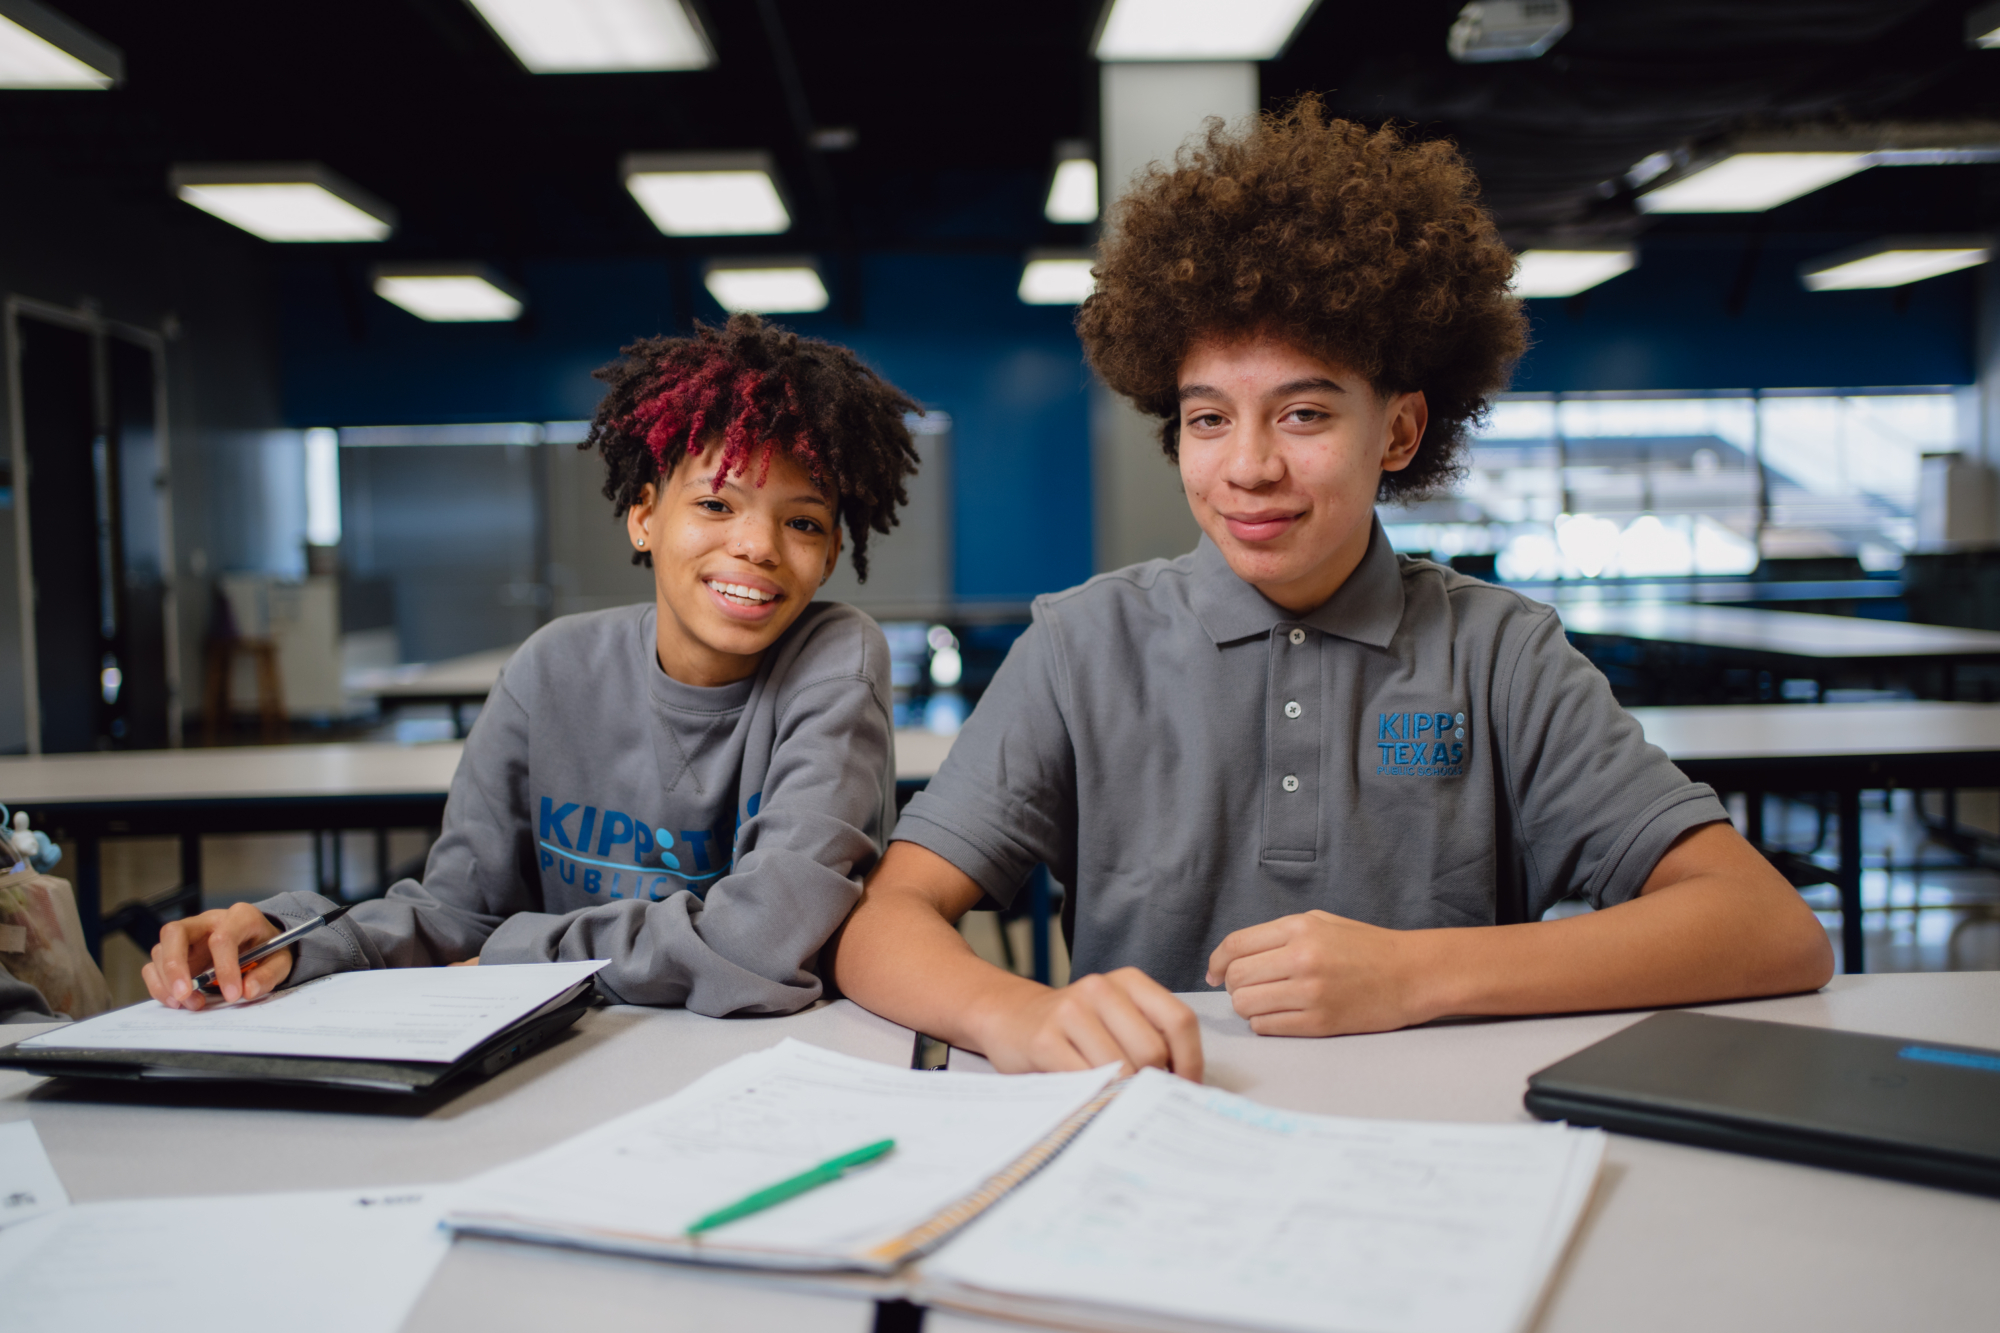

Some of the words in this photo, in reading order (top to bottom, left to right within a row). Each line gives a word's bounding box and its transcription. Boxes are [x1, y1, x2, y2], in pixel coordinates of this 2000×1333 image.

[1377, 742, 1463, 765] TEXAS
[1376, 766, 1415, 776] PUBLIC
[539, 849, 668, 900] PUBLIC
